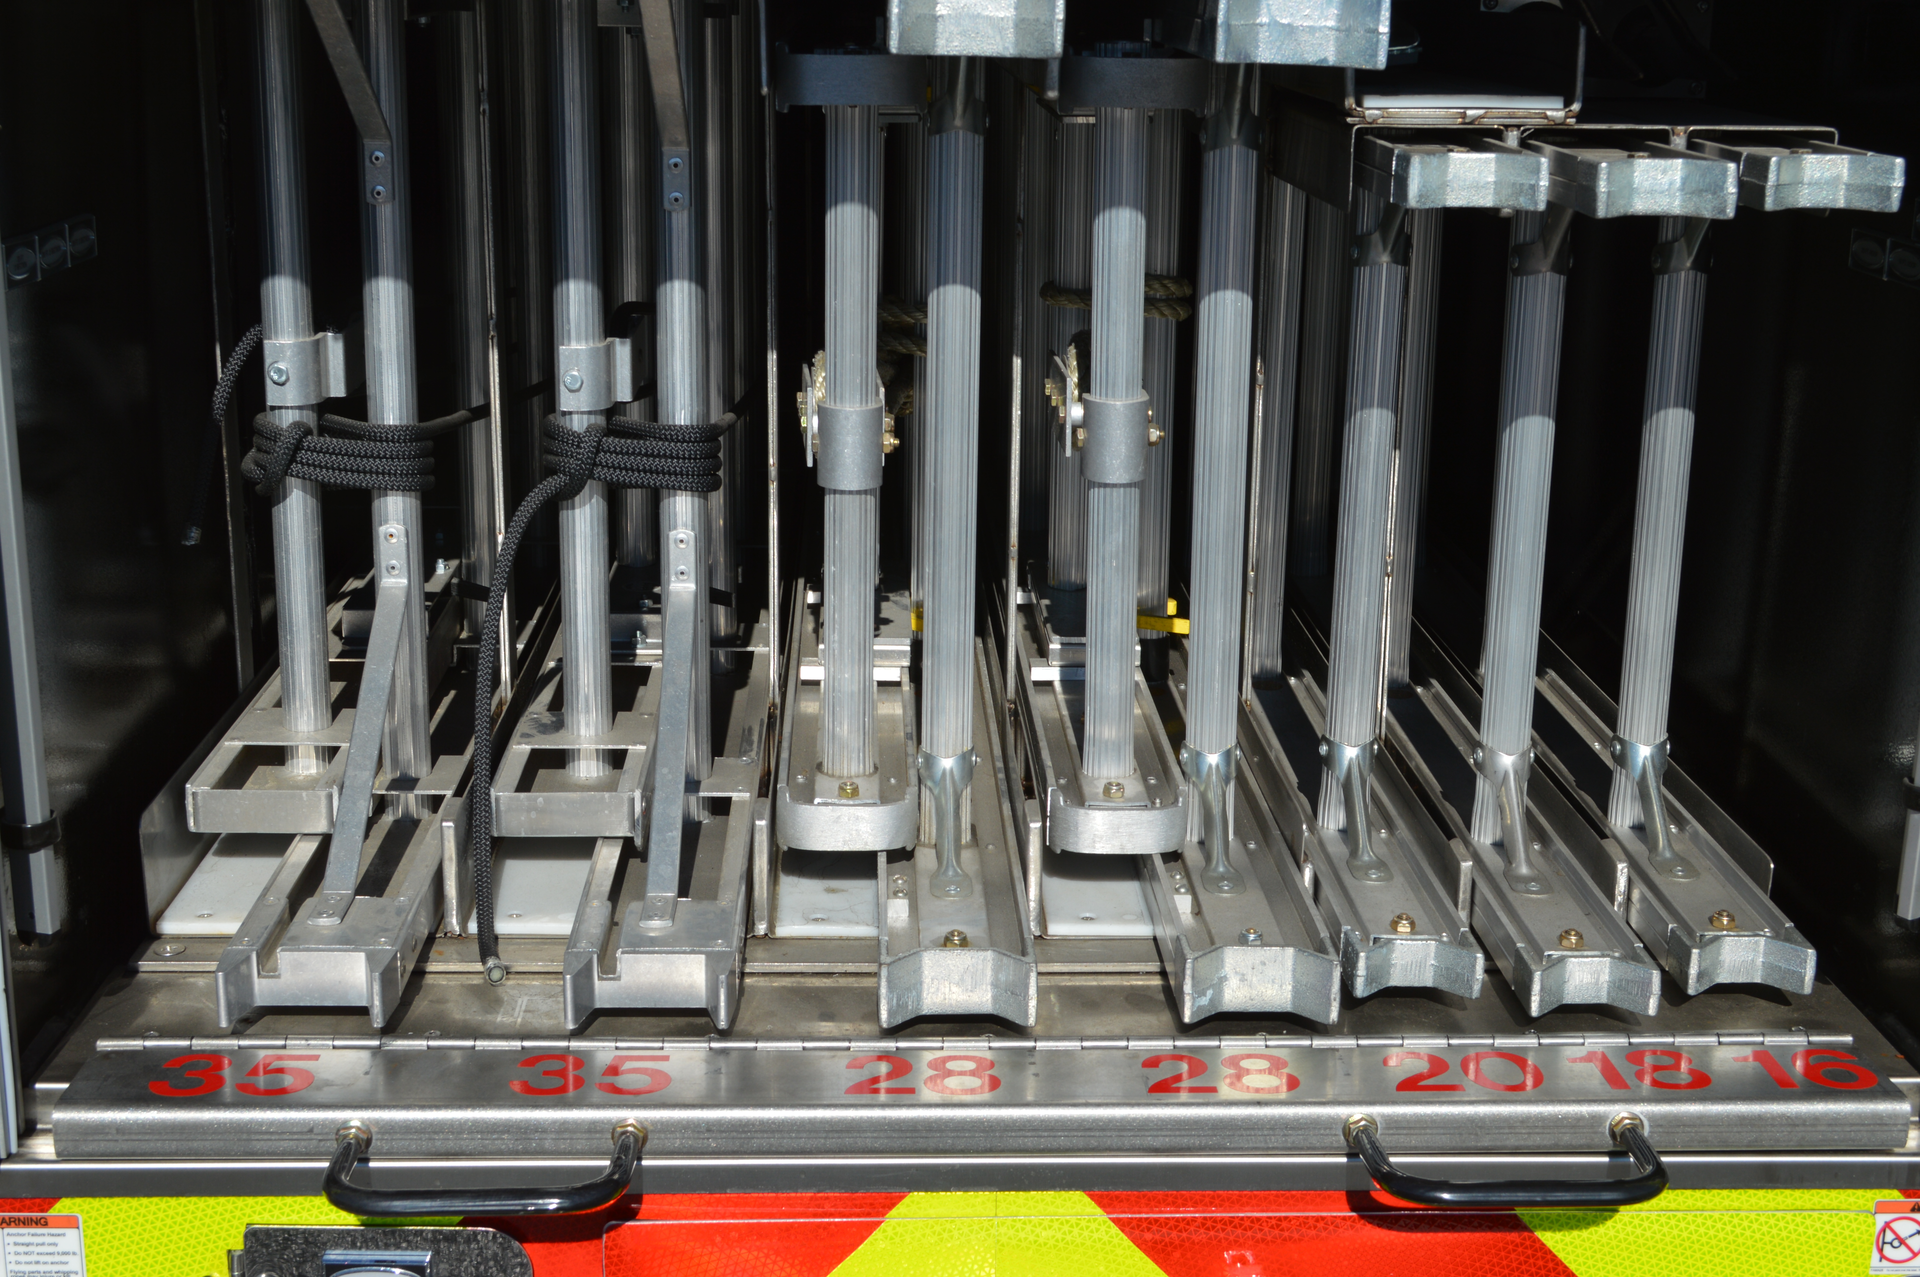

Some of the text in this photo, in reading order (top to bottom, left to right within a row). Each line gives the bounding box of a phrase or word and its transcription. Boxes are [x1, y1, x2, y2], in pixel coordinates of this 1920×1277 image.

[148, 1048, 1879, 1097] 35 35 28 28 20 18 16
[0, 1217, 48, 1226] ARNING
